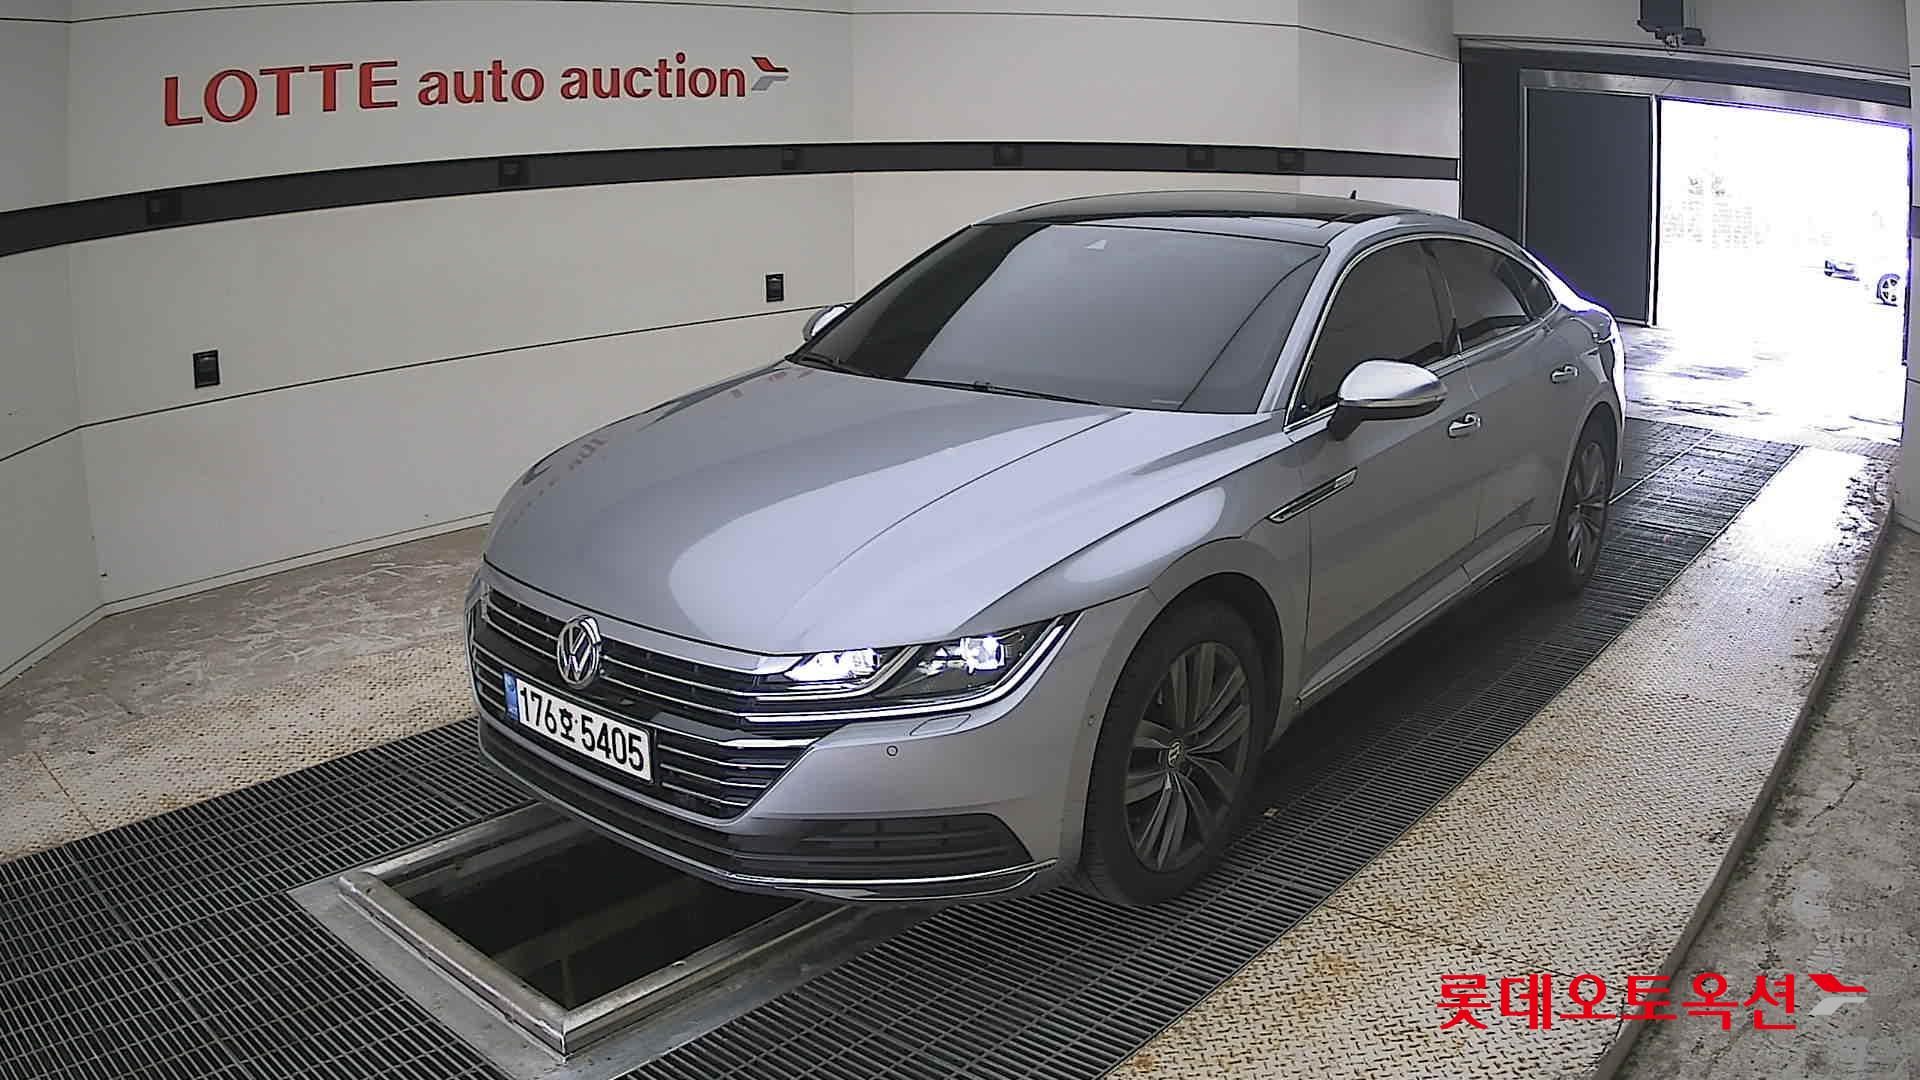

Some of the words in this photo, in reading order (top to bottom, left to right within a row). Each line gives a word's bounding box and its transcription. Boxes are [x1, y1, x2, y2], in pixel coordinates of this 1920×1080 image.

[164, 61, 398, 126] LOTTE
[417, 60, 545, 105] auto
[560, 52, 746, 99] auction
[519, 687, 575, 743] 176호
[581, 714, 644, 772] 5405
